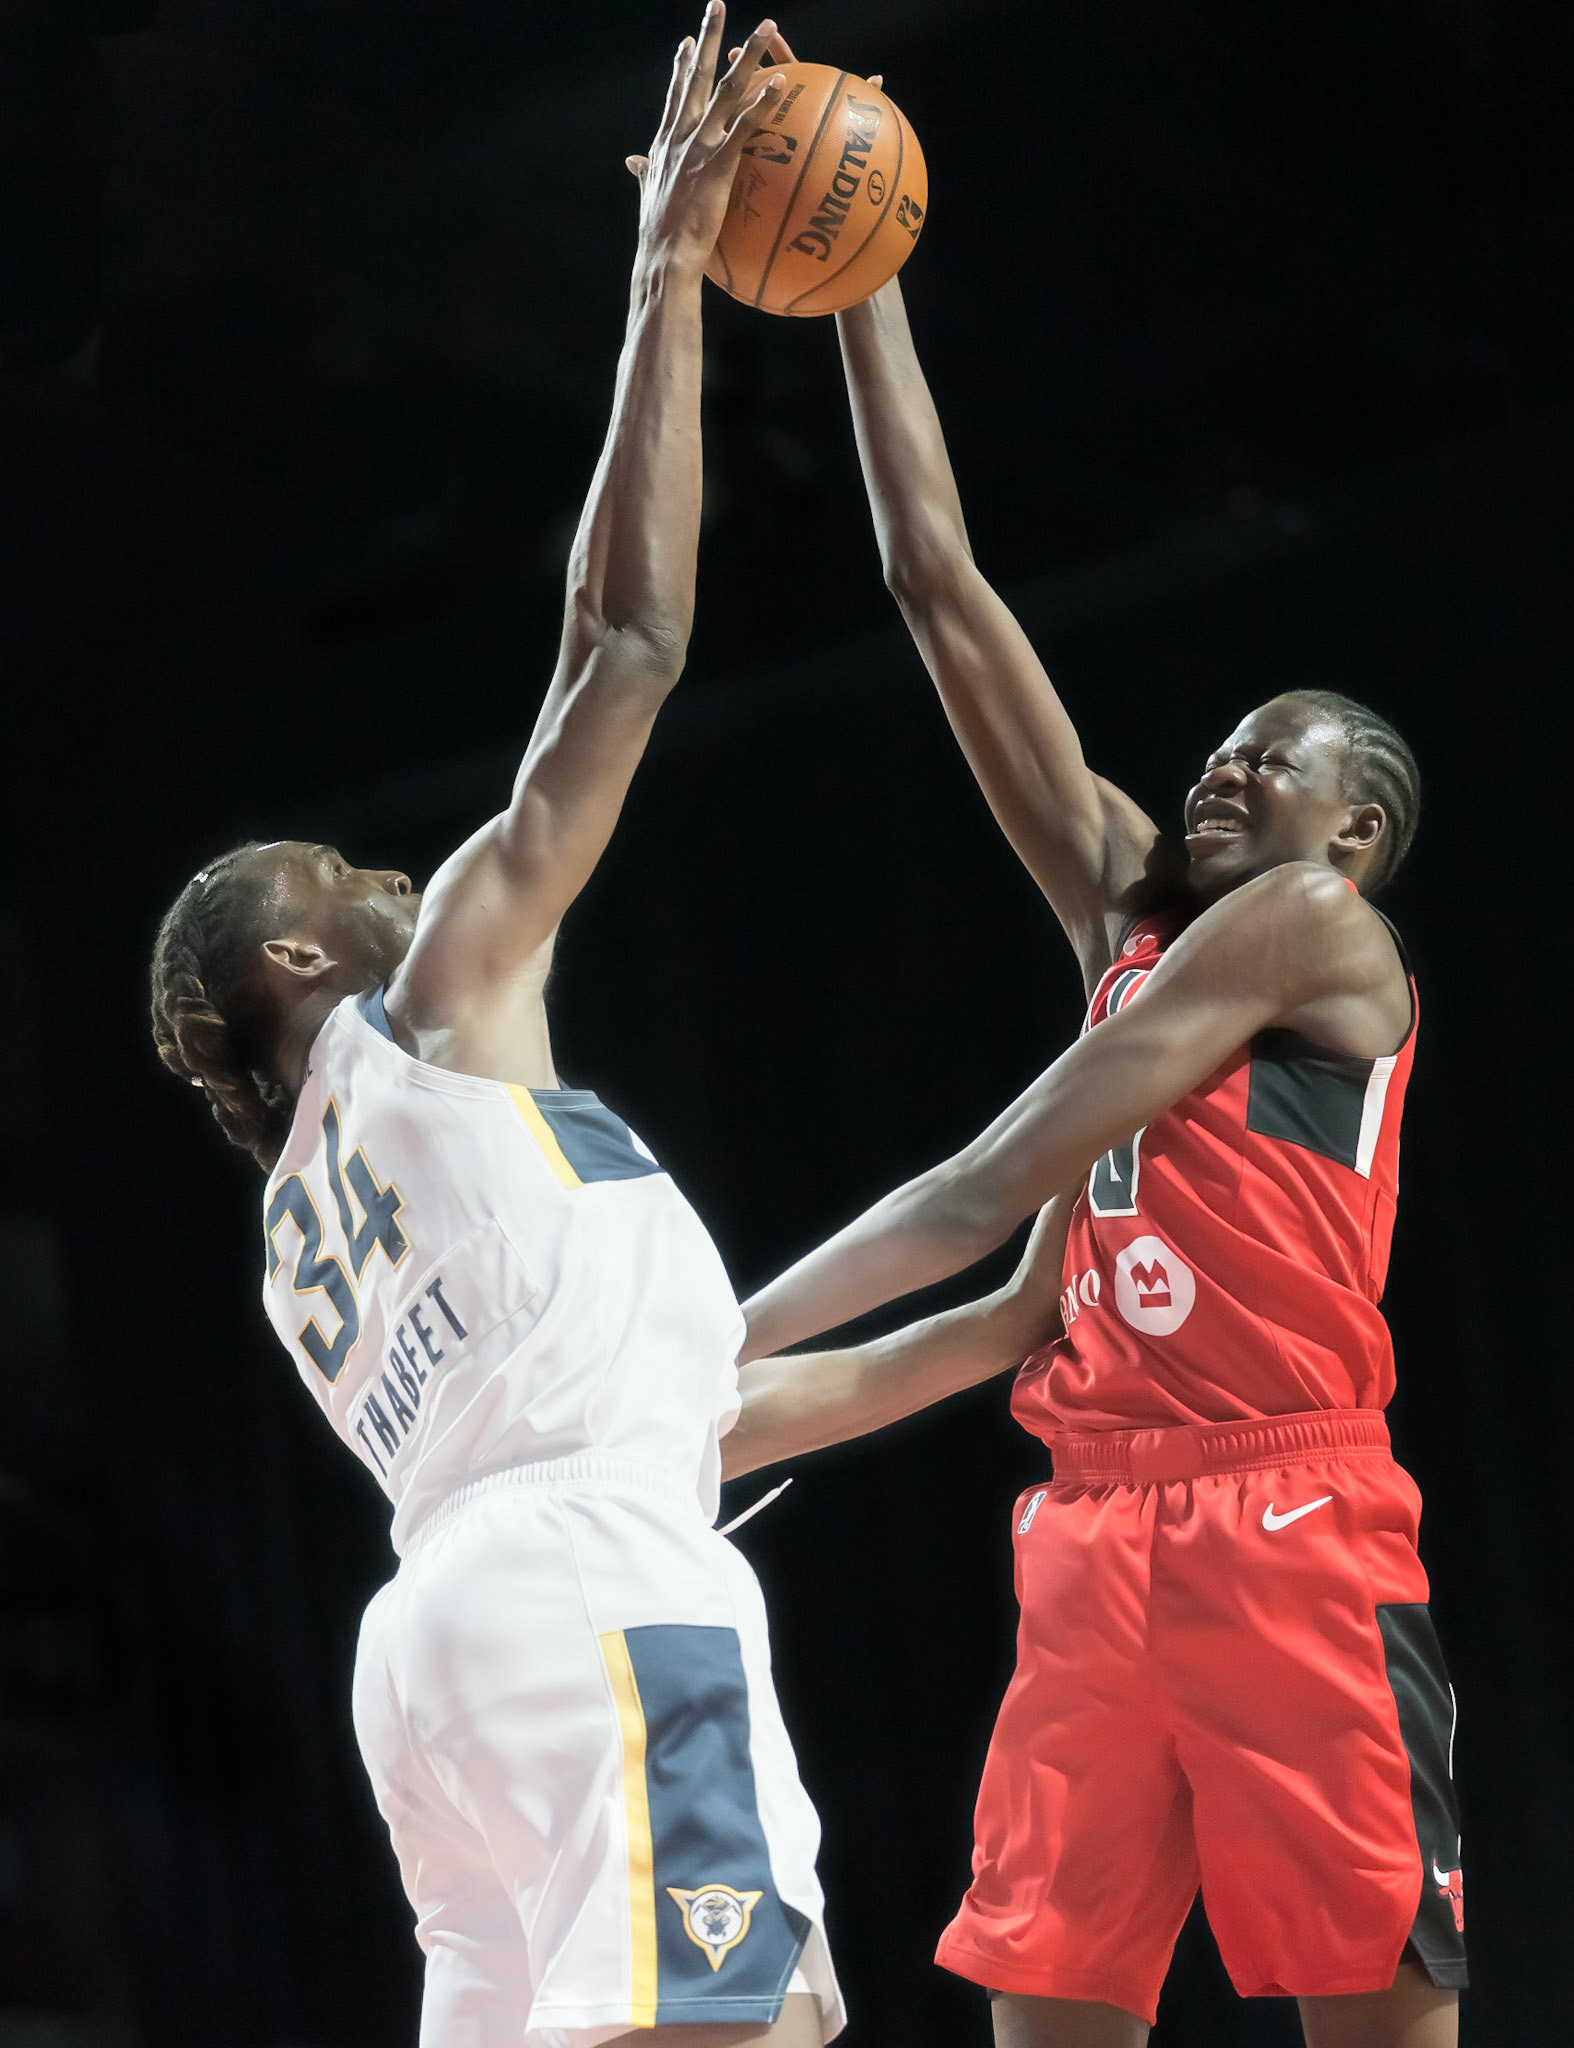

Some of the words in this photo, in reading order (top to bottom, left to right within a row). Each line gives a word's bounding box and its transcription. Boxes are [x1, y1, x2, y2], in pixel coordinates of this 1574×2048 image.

[790, 93, 882, 262] SPALDING
[264, 1094, 412, 1387] 34
[356, 1276, 469, 1480] THABEET
